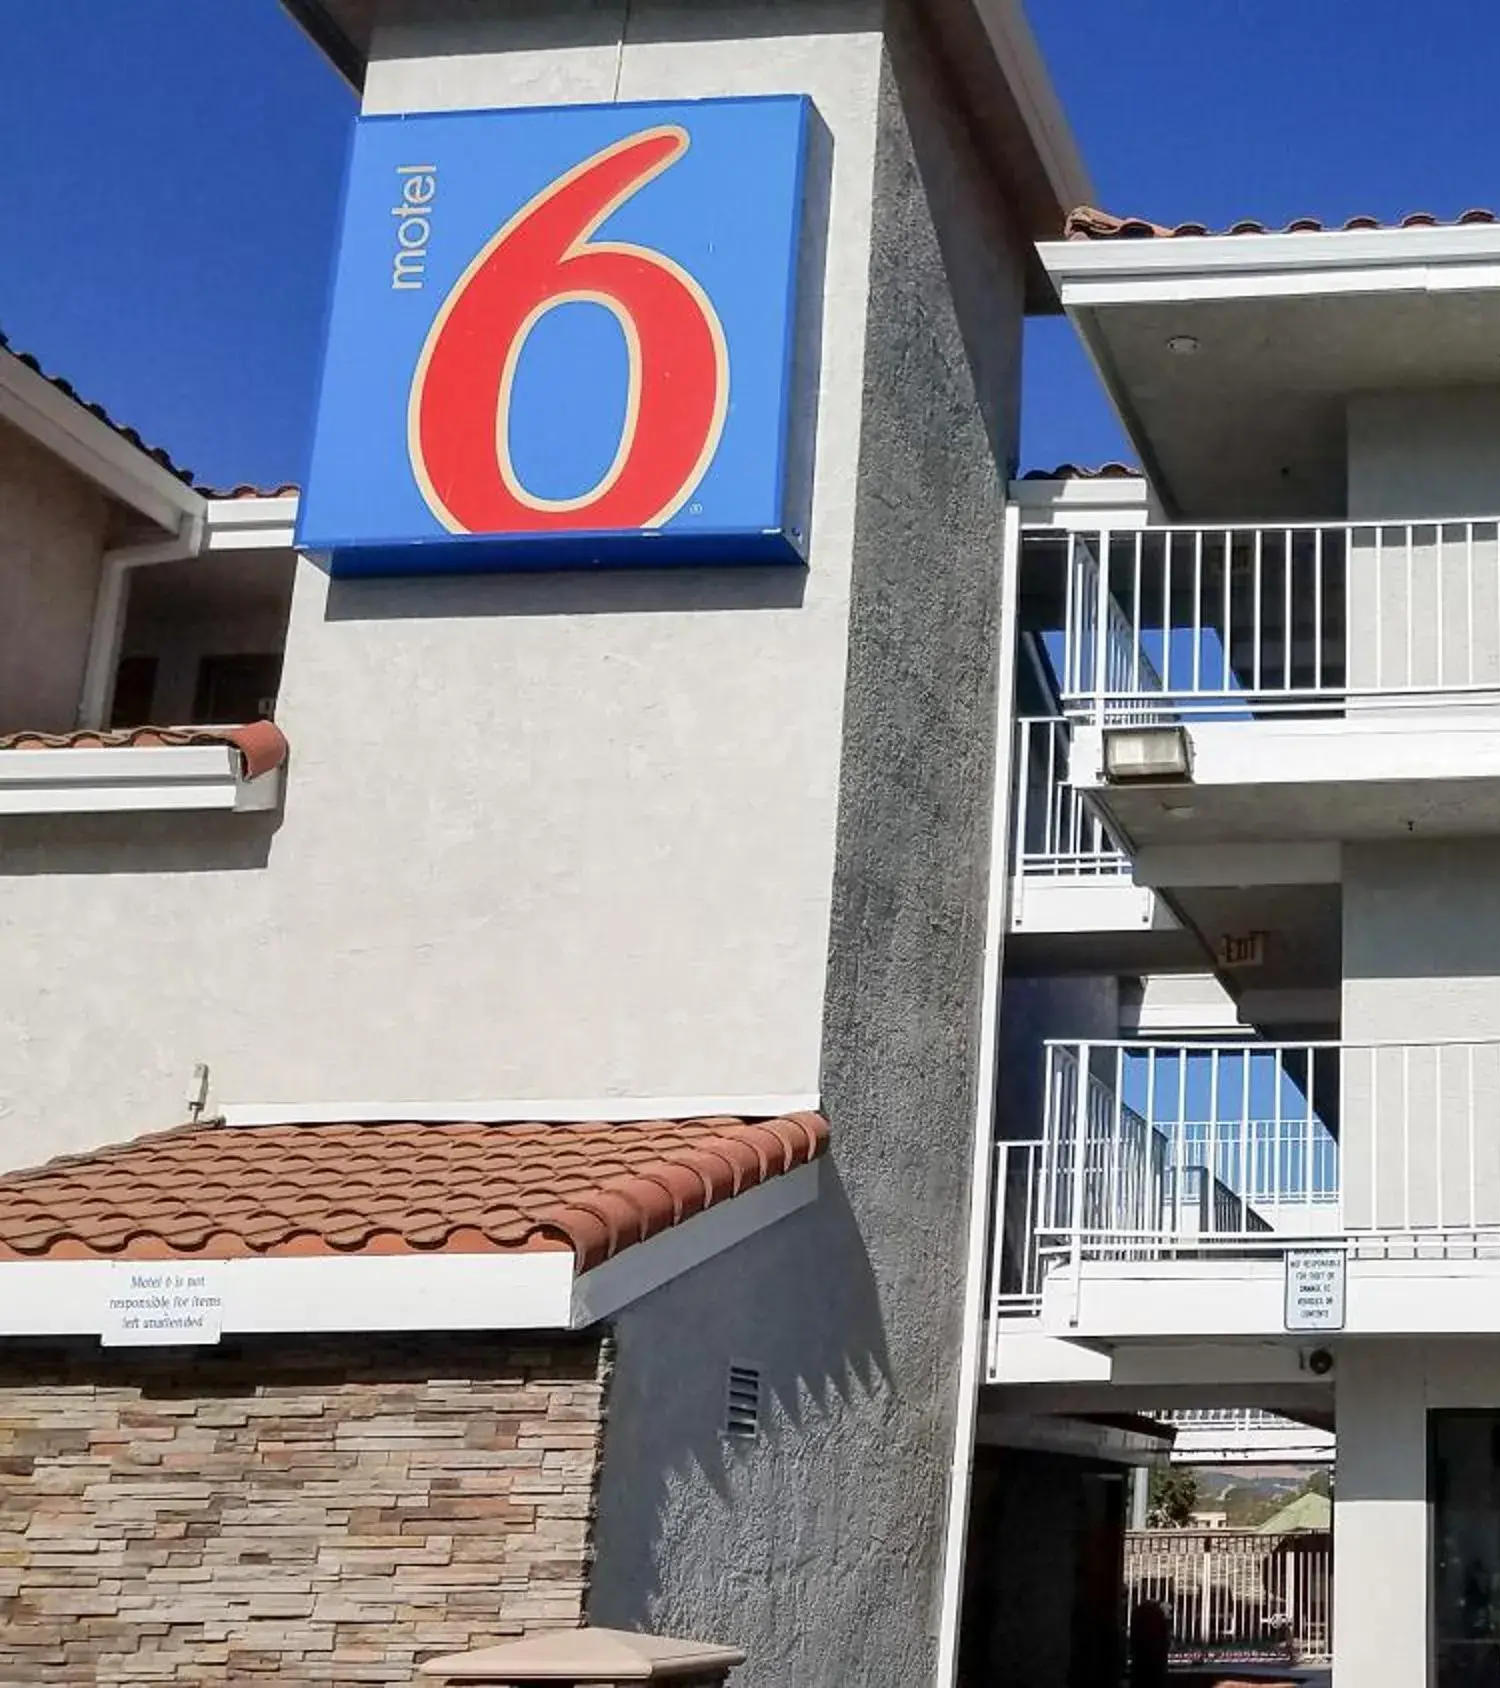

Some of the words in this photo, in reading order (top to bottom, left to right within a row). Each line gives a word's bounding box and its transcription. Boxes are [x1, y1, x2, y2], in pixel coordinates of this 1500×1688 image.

[391, 164, 437, 290] motel
[407, 123, 730, 535] 6
[131, 1275, 162, 1288] Motel
[165, 1275, 172, 1288] 6
[175, 1275, 184, 1287] is
[187, 1276, 205, 1287] not
[109, 1296, 170, 1310] responsible
[173, 1296, 188, 1308] for
[191, 1296, 221, 1307] items
[122, 1316, 139, 1329] left
[143, 1316, 204, 1329] unattended
